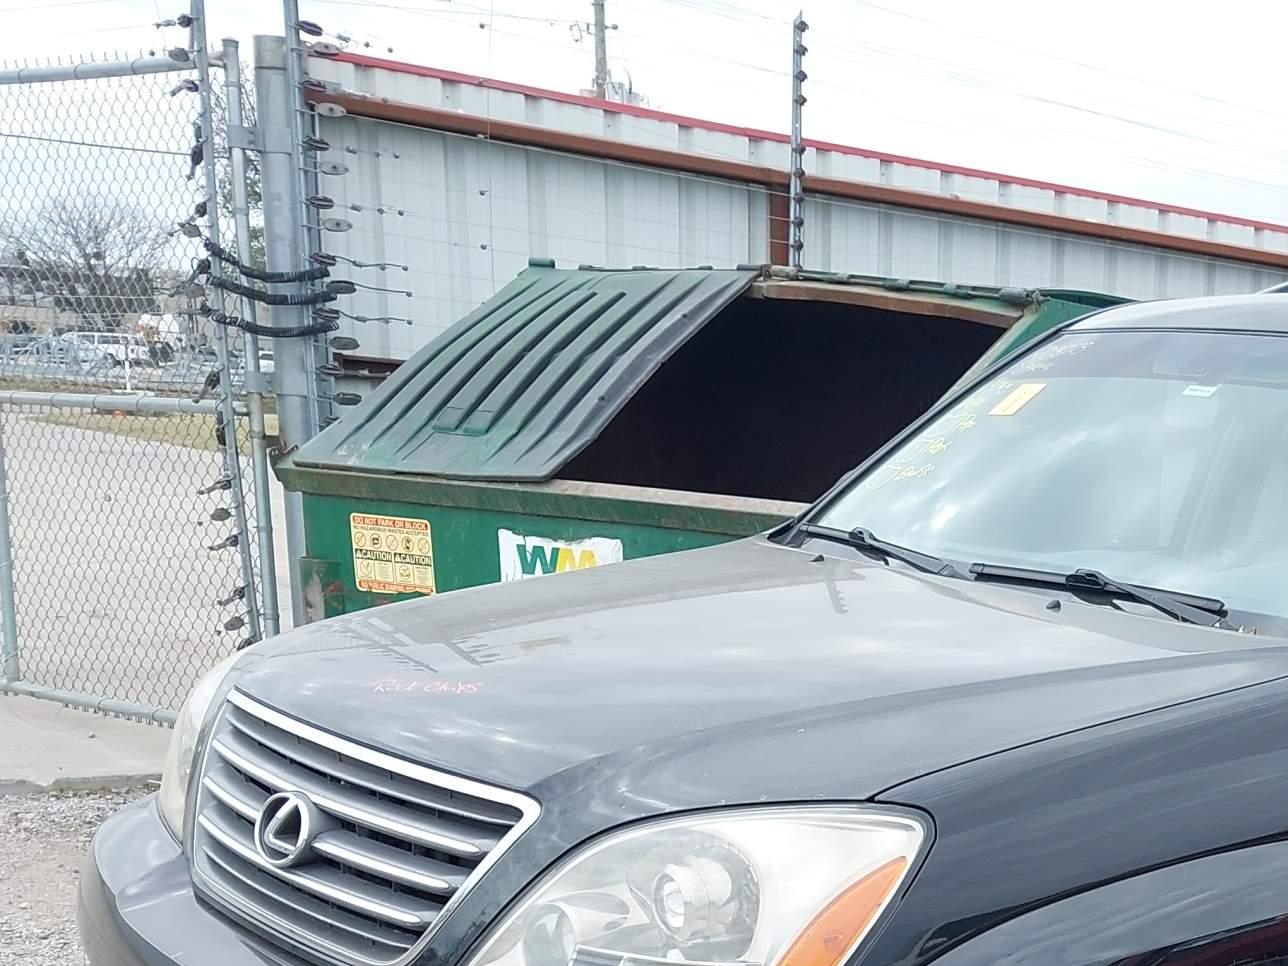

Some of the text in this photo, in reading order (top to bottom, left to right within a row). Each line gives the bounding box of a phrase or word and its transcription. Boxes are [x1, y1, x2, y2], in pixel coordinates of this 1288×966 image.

[354, 516, 427, 530] DO NOT PARK OR BLOCK
[361, 550, 392, 561] CAUTION
[400, 554, 431, 566] CAUTION
